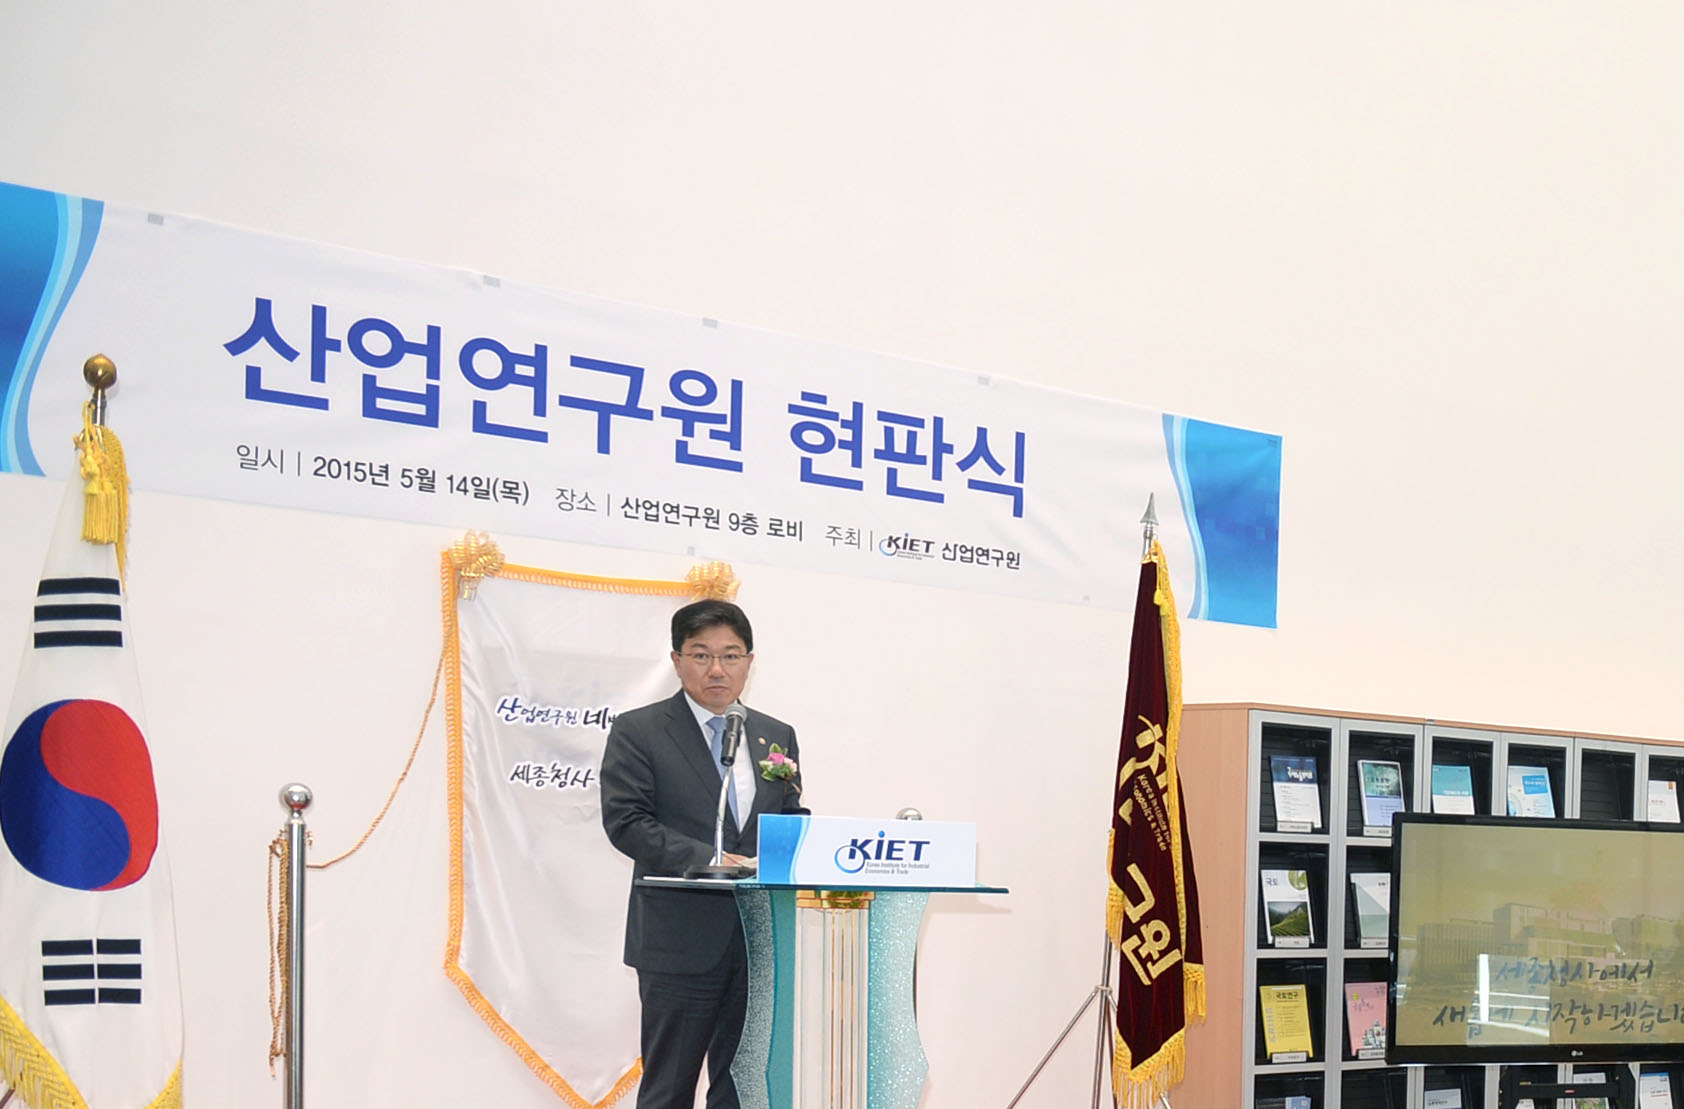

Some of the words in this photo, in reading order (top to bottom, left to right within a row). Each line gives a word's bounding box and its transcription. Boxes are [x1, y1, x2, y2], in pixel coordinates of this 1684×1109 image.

[225, 298, 743, 473] 산업연구원
[789, 391, 1026, 518] 현판식
[236, 444, 284, 474] 일시
[313, 455, 390, 488] 2015년
[400, 467, 437, 494] 5월
[446, 473, 531, 506] 14일(목)
[555, 487, 597, 512] 장소
[620, 496, 720, 530] 산업연구원
[728, 512, 759, 535] 9층
[766, 517, 803, 541] 로비
[825, 523, 861, 549] 주최
[942, 542, 1021, 570] 산업연구원
[497, 696, 579, 726] 산업연구원
[583, 706, 617, 730] 네
[510, 762, 595, 788] 세종청사
[1137, 774, 1154, 799] Korea
[1154, 828, 1168, 852] Trade
[1495, 956, 1654, 992] 세종청사에서
